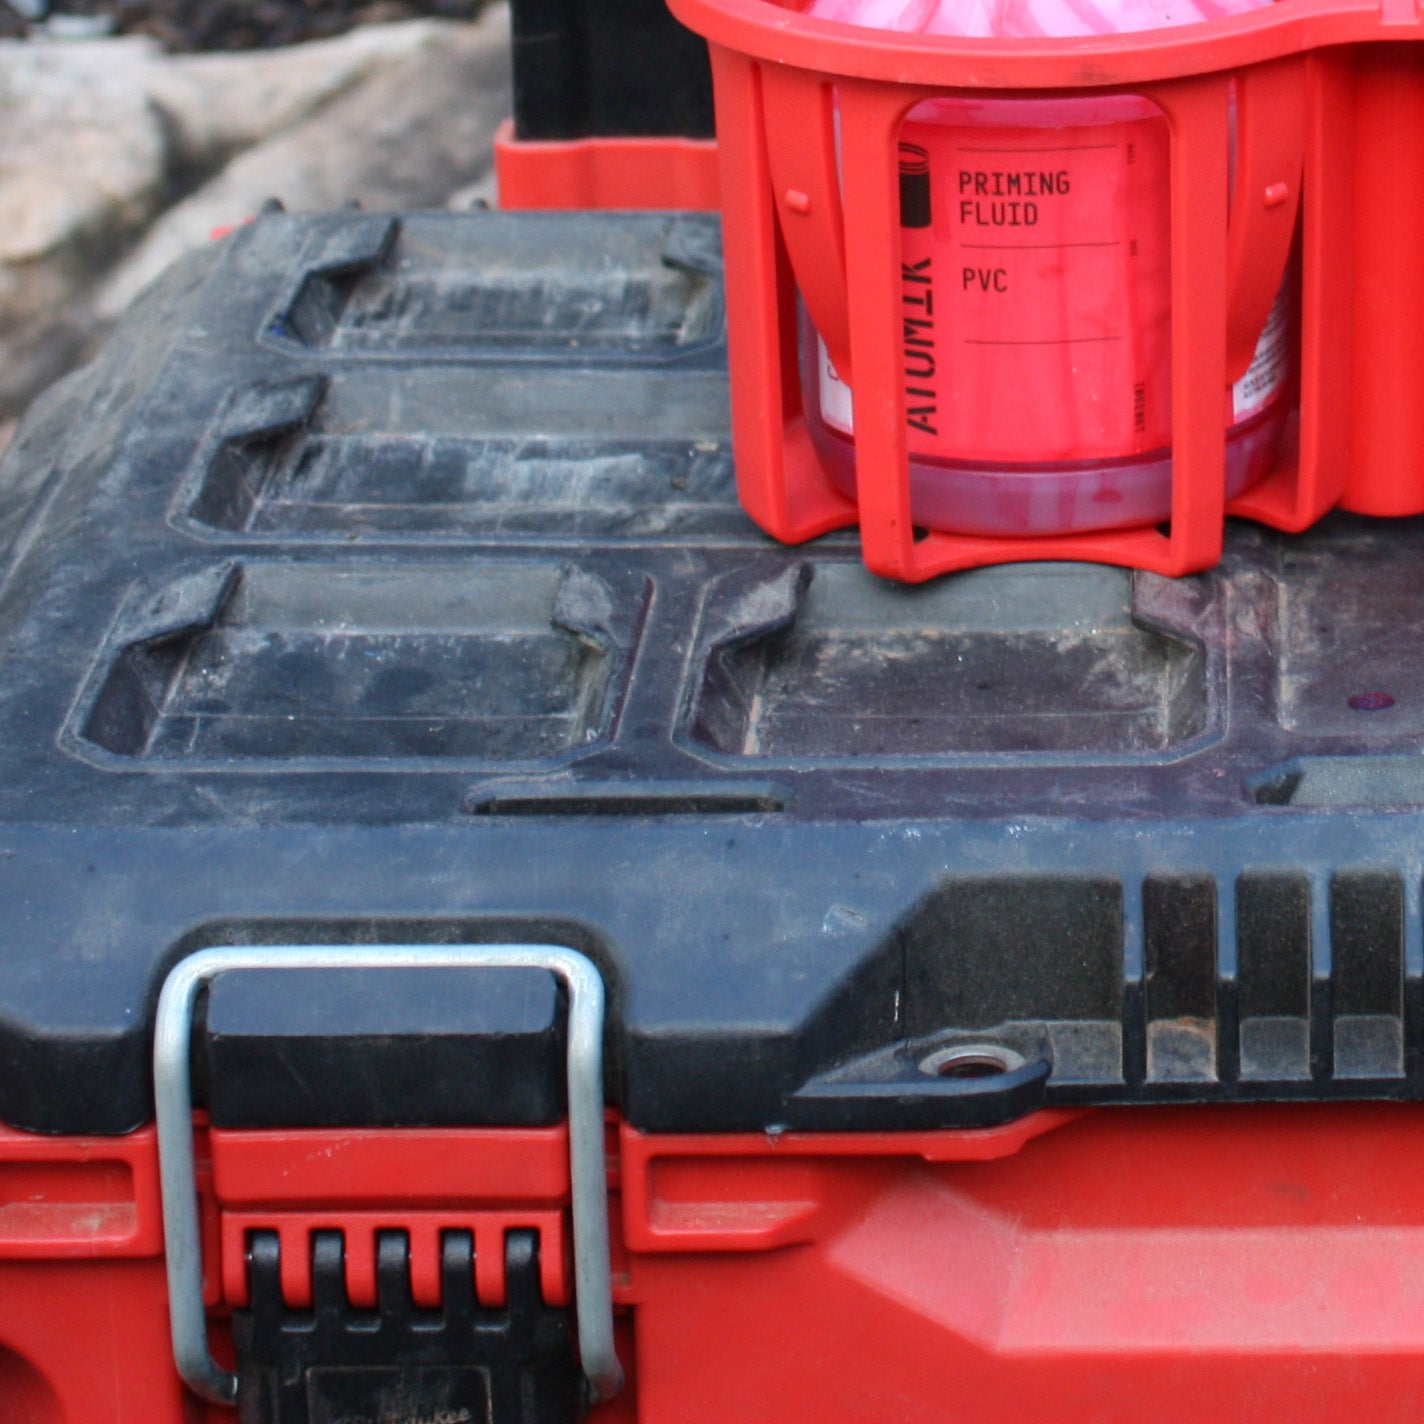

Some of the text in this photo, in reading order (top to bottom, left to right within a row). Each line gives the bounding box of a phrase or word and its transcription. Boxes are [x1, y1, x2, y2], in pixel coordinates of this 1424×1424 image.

[958, 170, 1071, 196] PRIMING
[959, 201, 1039, 227] FLUID
[961, 268, 1009, 293] PVC
